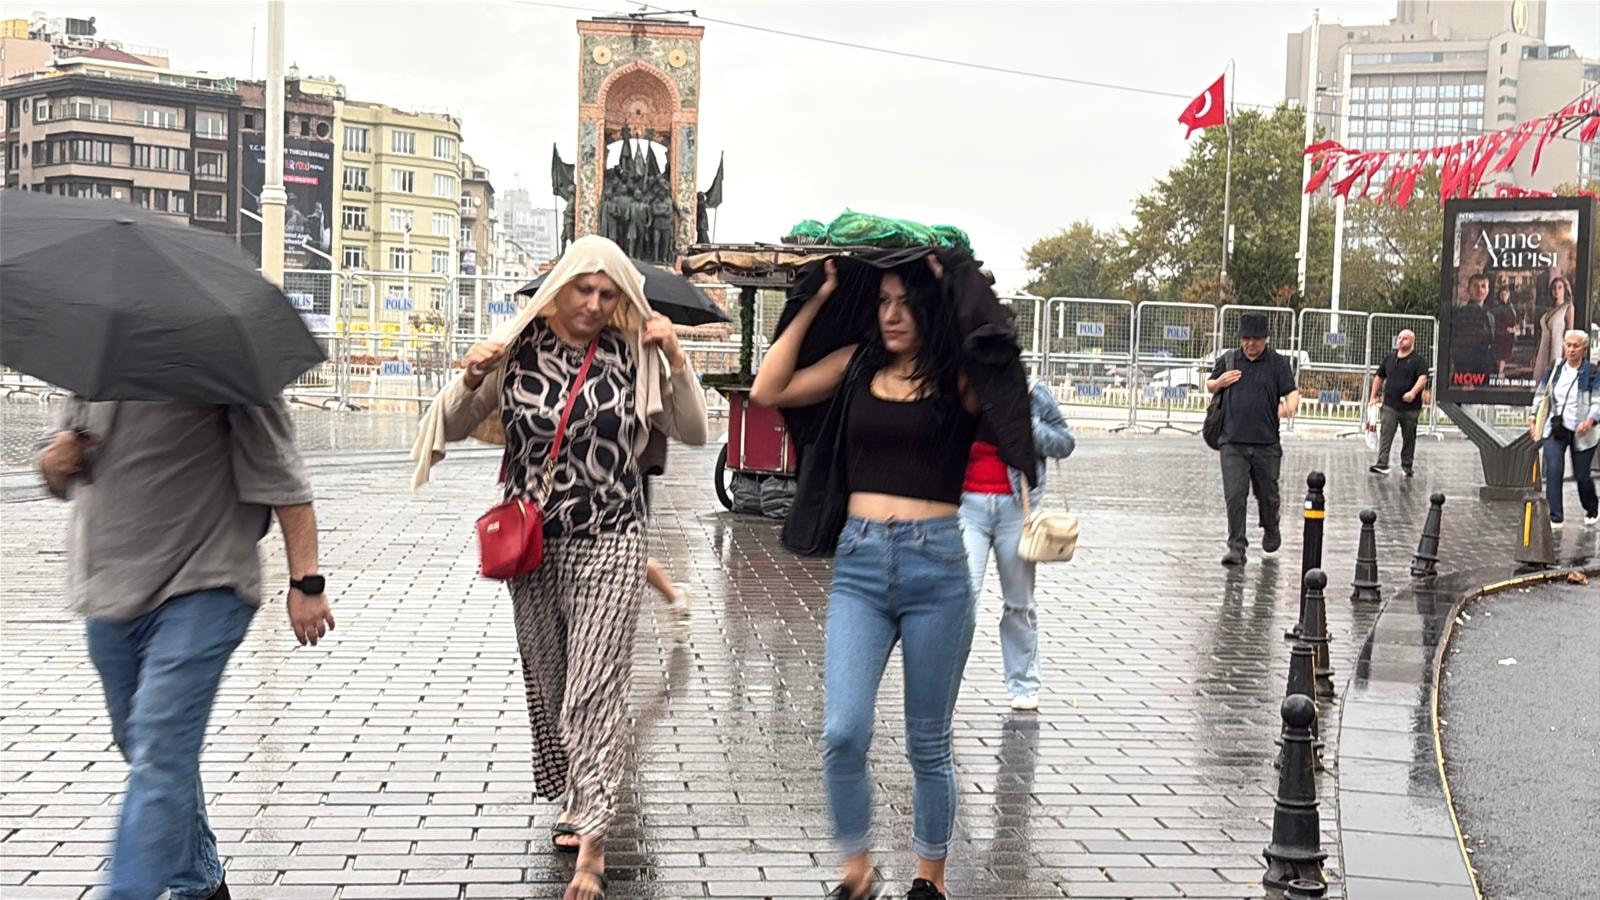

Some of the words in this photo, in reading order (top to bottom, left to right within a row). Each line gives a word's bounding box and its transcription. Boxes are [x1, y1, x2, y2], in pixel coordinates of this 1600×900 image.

[1473, 229, 1542, 250] Anne
[1487, 247, 1558, 268] Yarısı
[385, 298, 412, 310] POLİS
[488, 301, 515, 313] POLİS
[1079, 324, 1103, 334] POLİS
[1166, 328, 1188, 338] POLİS
[384, 363, 410, 375] POLİS
[1454, 373, 1485, 385] NOW
[1077, 383, 1100, 395] POLİS
[1164, 387, 1186, 398] POLİS
